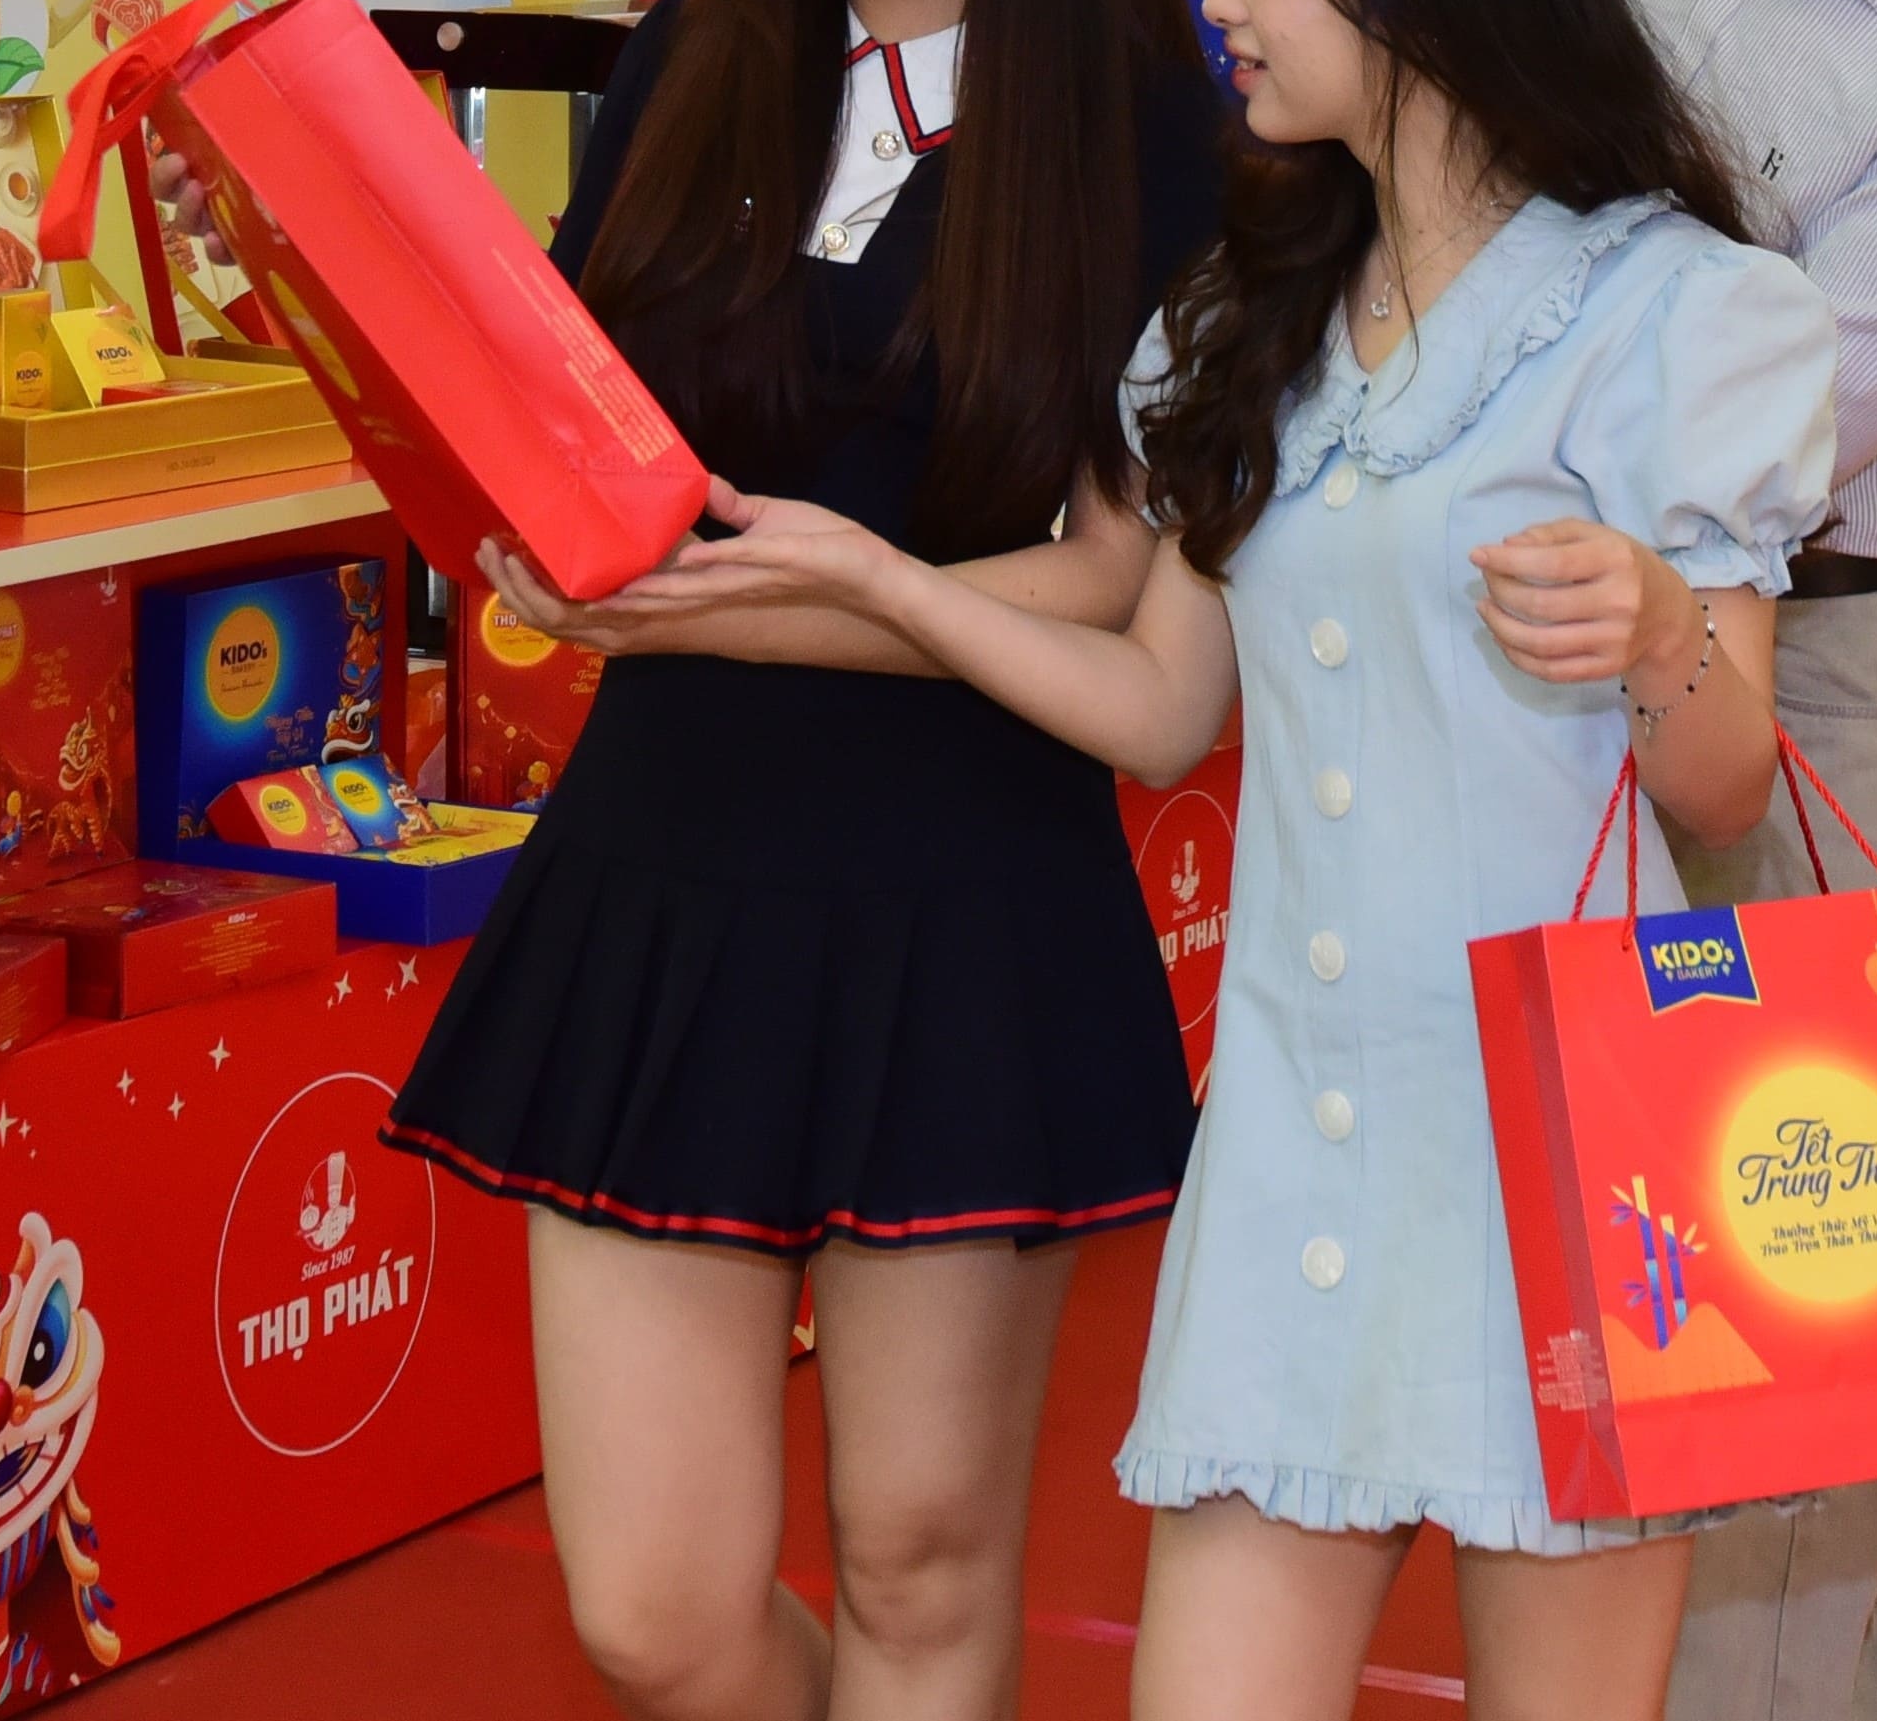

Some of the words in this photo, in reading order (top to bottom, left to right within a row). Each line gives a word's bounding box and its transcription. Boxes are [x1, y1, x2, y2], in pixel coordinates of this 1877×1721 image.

[220, 639, 268, 668] KIDO's
[1184, 904, 1229, 957] PHÁT
[1650, 936, 1735, 971] KIDO's
[1677, 965, 1718, 982] BAKERY
[1776, 1118, 1833, 1170] Tết
[1738, 1153, 1832, 1208] Trung
[300, 1256, 329, 1282] Since
[329, 1245, 357, 1271] 1987
[238, 1294, 310, 1368] THỌ
[323, 1248, 415, 1336] PHÁT
